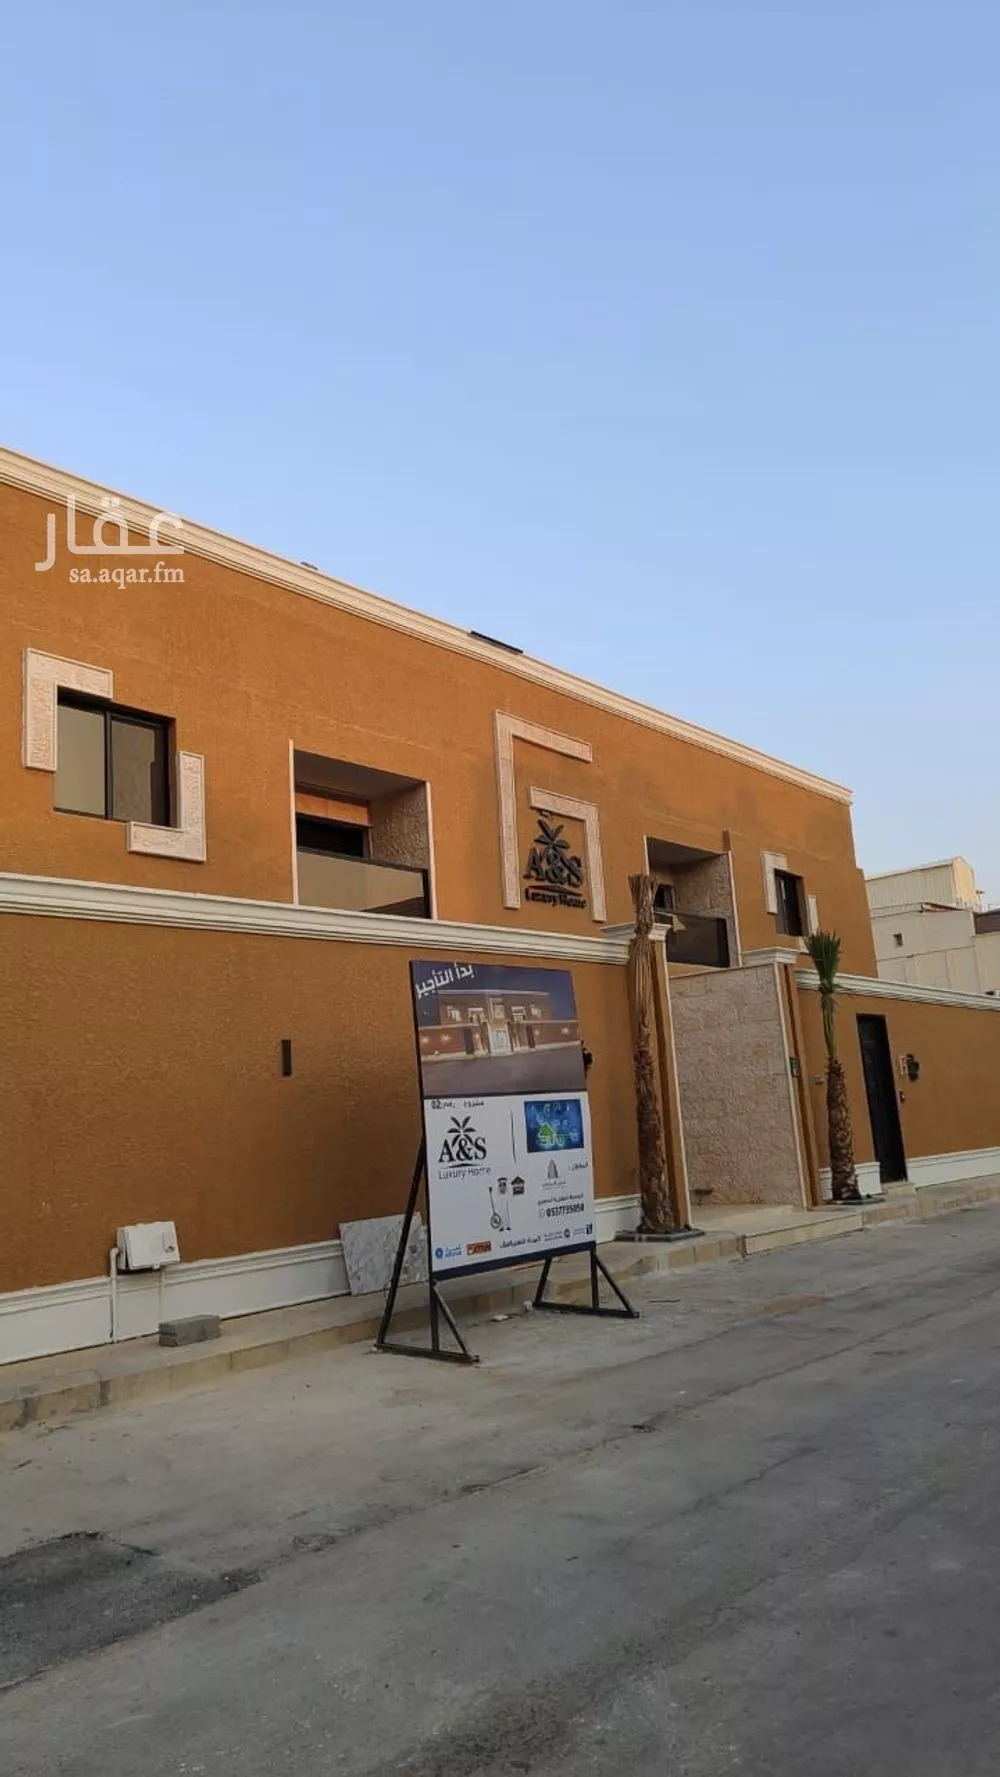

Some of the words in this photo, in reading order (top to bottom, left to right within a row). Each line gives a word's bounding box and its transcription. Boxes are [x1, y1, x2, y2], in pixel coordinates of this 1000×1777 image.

[523, 847, 584, 888] A&S
[415, 968, 454, 1000] التأجير
[454, 962, 475, 980] بدأ
[438, 1136, 488, 1163] A&S
[438, 1170, 466, 1180] Luxury
[468, 1166, 492, 1177] Home
